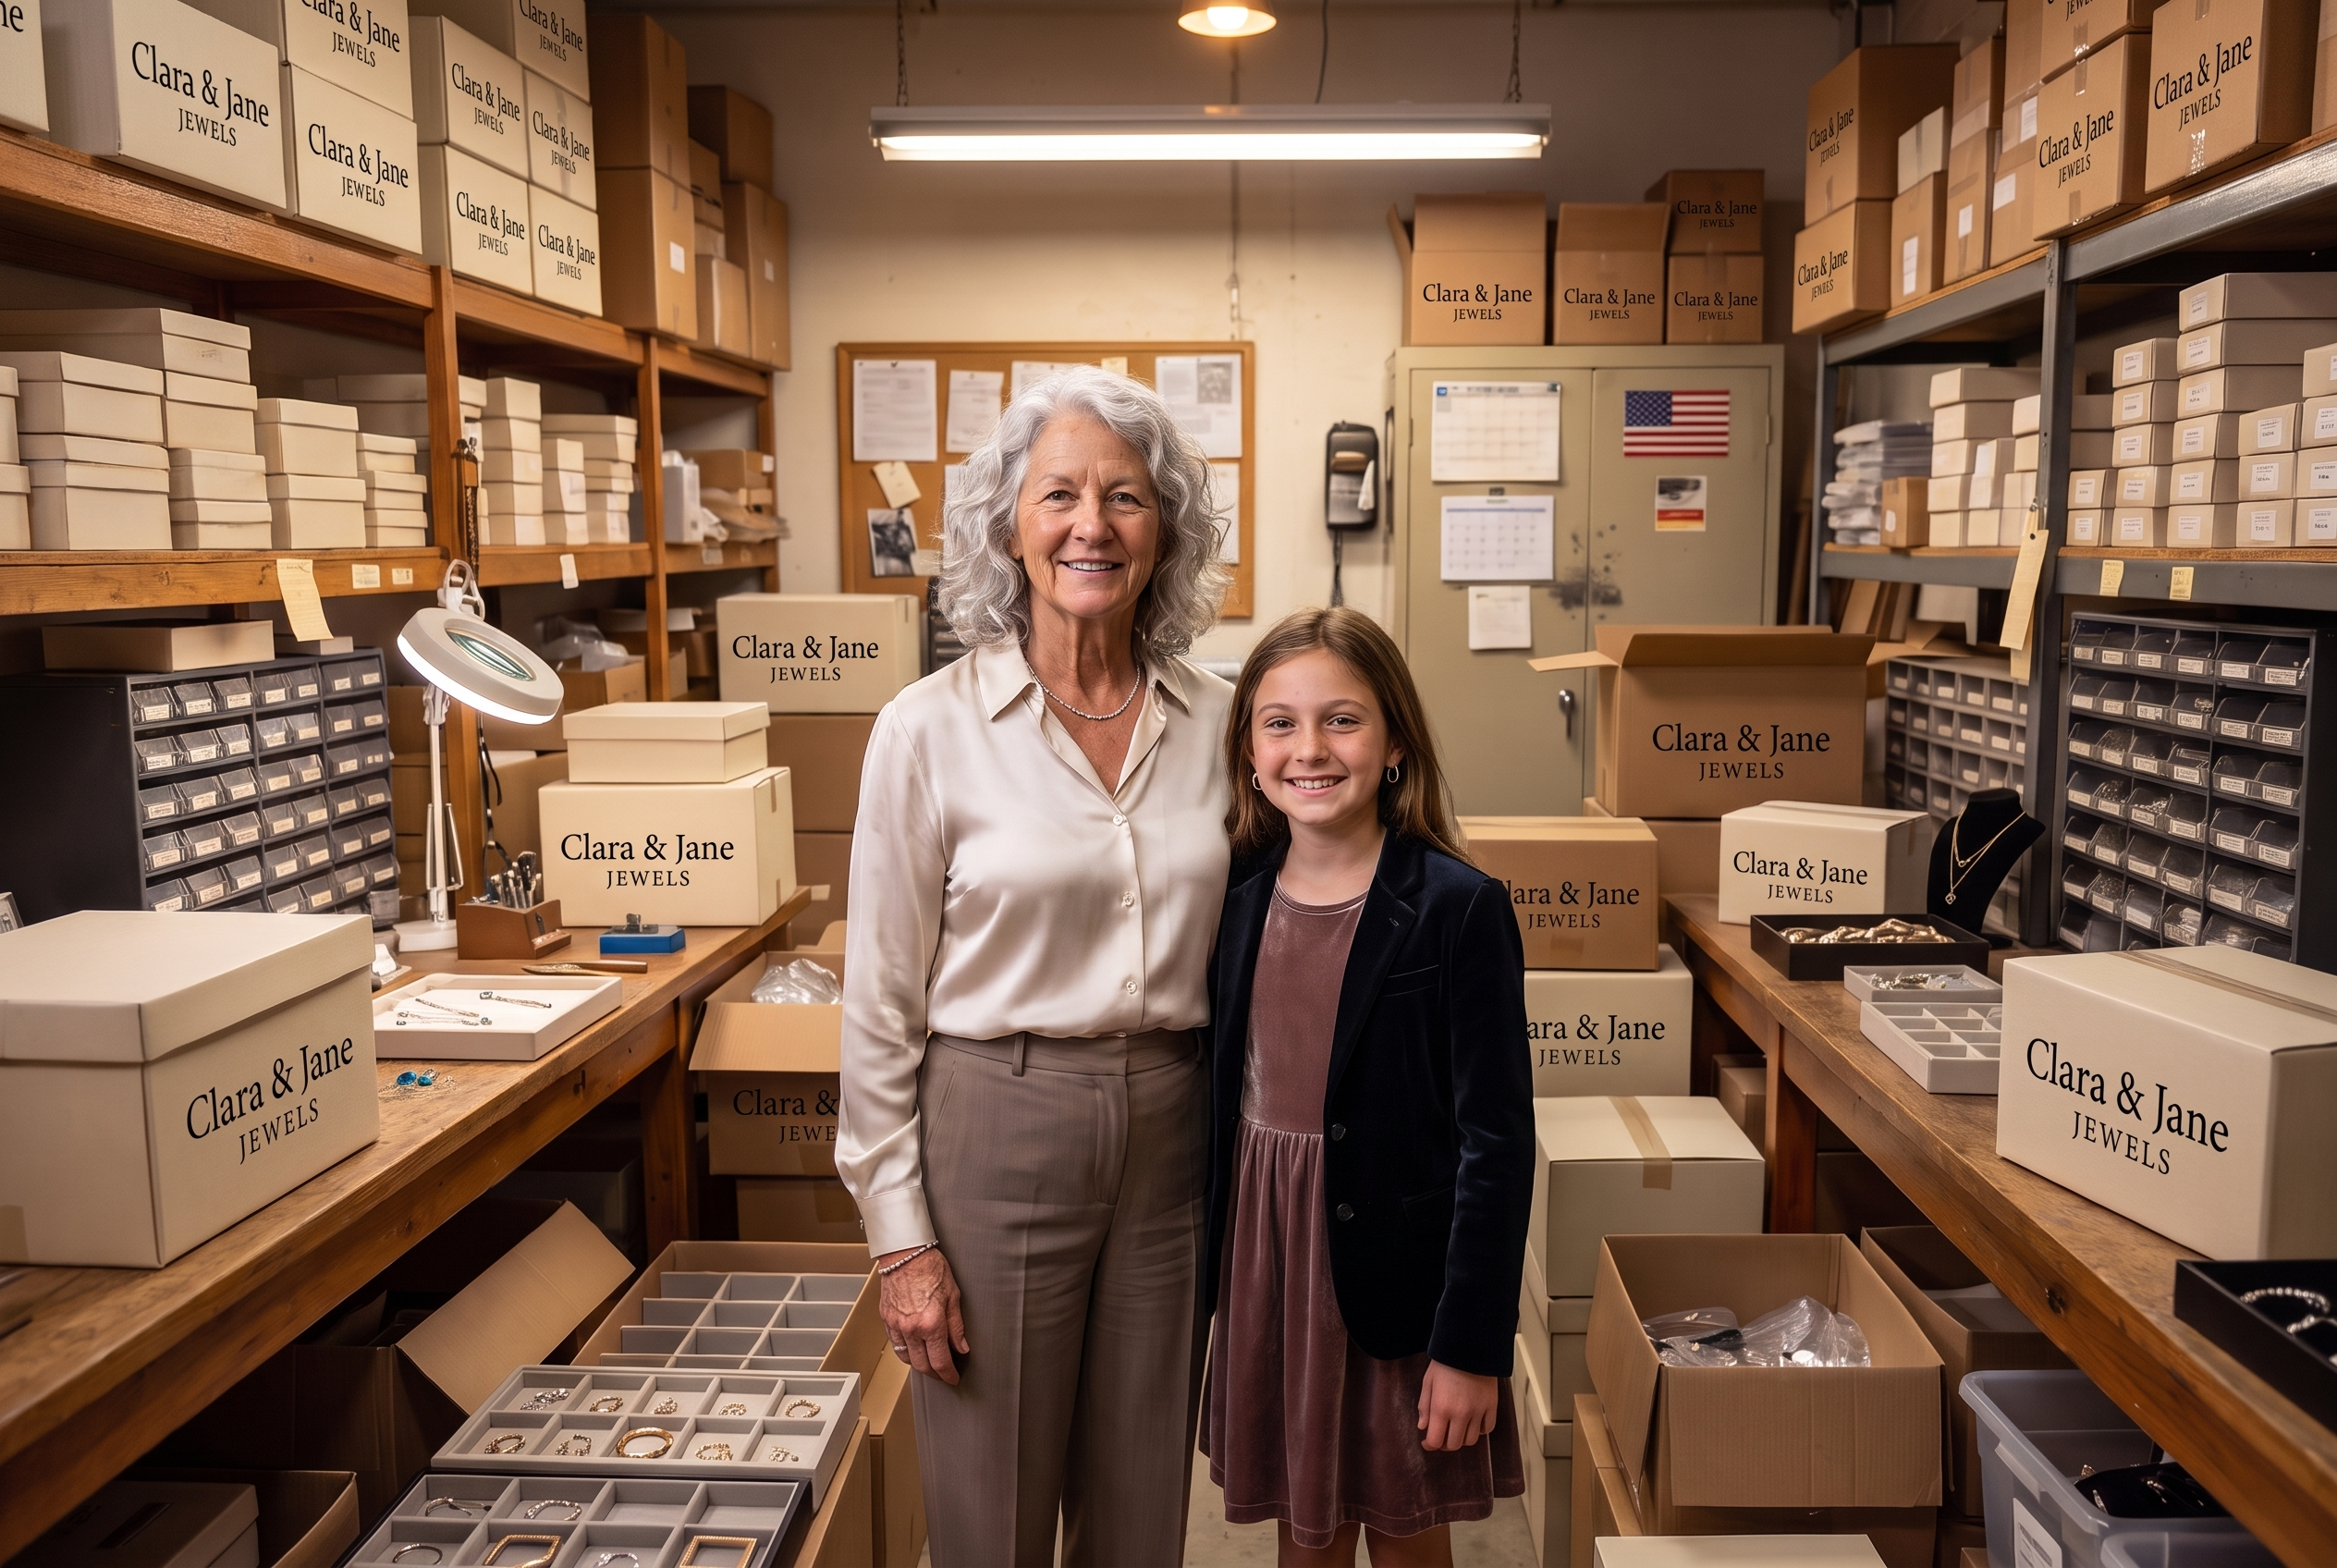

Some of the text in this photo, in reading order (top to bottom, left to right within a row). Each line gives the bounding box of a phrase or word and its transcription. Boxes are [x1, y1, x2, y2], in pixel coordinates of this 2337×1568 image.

[349, 2, 362, 33] &
[367, 9, 399, 53] Jane
[551, 12, 558, 36] &
[561, 18, 582, 52] Jane
[333, 31, 375, 67] JEWELS
[132, 42, 268, 127] Clara & Jane
[2155, 36, 2252, 109] Clara & Jane
[452, 63, 521, 121] Clara & Jane
[474, 107, 504, 135] JEWELS
[2179, 89, 2221, 131] JEWELS
[178, 108, 236, 146] JEWELS
[533, 111, 589, 161] Clara & Jane
[1809, 108, 1854, 152] Clara & Jane
[2039, 111, 2113, 167] Clara & Jane
[309, 124, 408, 188] Clara & Jane
[2058, 153, 2090, 188] JEWELS
[342, 177, 385, 206] JEWELS
[457, 192, 525, 240] Clara & Jane
[1677, 200, 1756, 217] Clara & Jane
[1699, 219, 1734, 229] JEWELS
[479, 233, 508, 255] JEWELS
[539, 225, 594, 264] Clara & Jane
[557, 261, 581, 280] JEWELS
[1798, 251, 1847, 286] Clara & Jane
[1424, 283, 1532, 306] Clara & Jane
[1564, 288, 1655, 308] Clara & Jane
[1674, 291, 1757, 309] Clara & Jane
[1453, 309, 1501, 322] JEWELS
[1590, 310, 1630, 321] JEWELS
[1698, 312, 1733, 322] JEWELS
[733, 635, 878, 663] Clara & Jane
[771, 668, 840, 683] JEWELS
[1653, 723, 1829, 757] Clara & Jane
[1699, 763, 1783, 781] JEWELS
[561, 833, 734, 864] Clara & Jane
[607, 871, 689, 888] JEWELS
[1734, 851, 1867, 885] Clara & Jane
[1507, 879, 1639, 909] lara & Jane
[1768, 885, 1832, 903] JEWELS
[1528, 914, 1600, 929] JEWELS
[1526, 1014, 1665, 1045] ara & Jane
[1539, 1049, 1621, 1067] JEWELS
[187, 1038, 353, 1139] Clara & Jane
[733, 1088, 838, 1115] Clara &
[2027, 1038, 2228, 1152] Clara & Jane
[239, 1098, 318, 1165] JEWELS
[779, 1126, 836, 1144] JEWE
[2073, 1111, 2169, 1174] JEWELS
